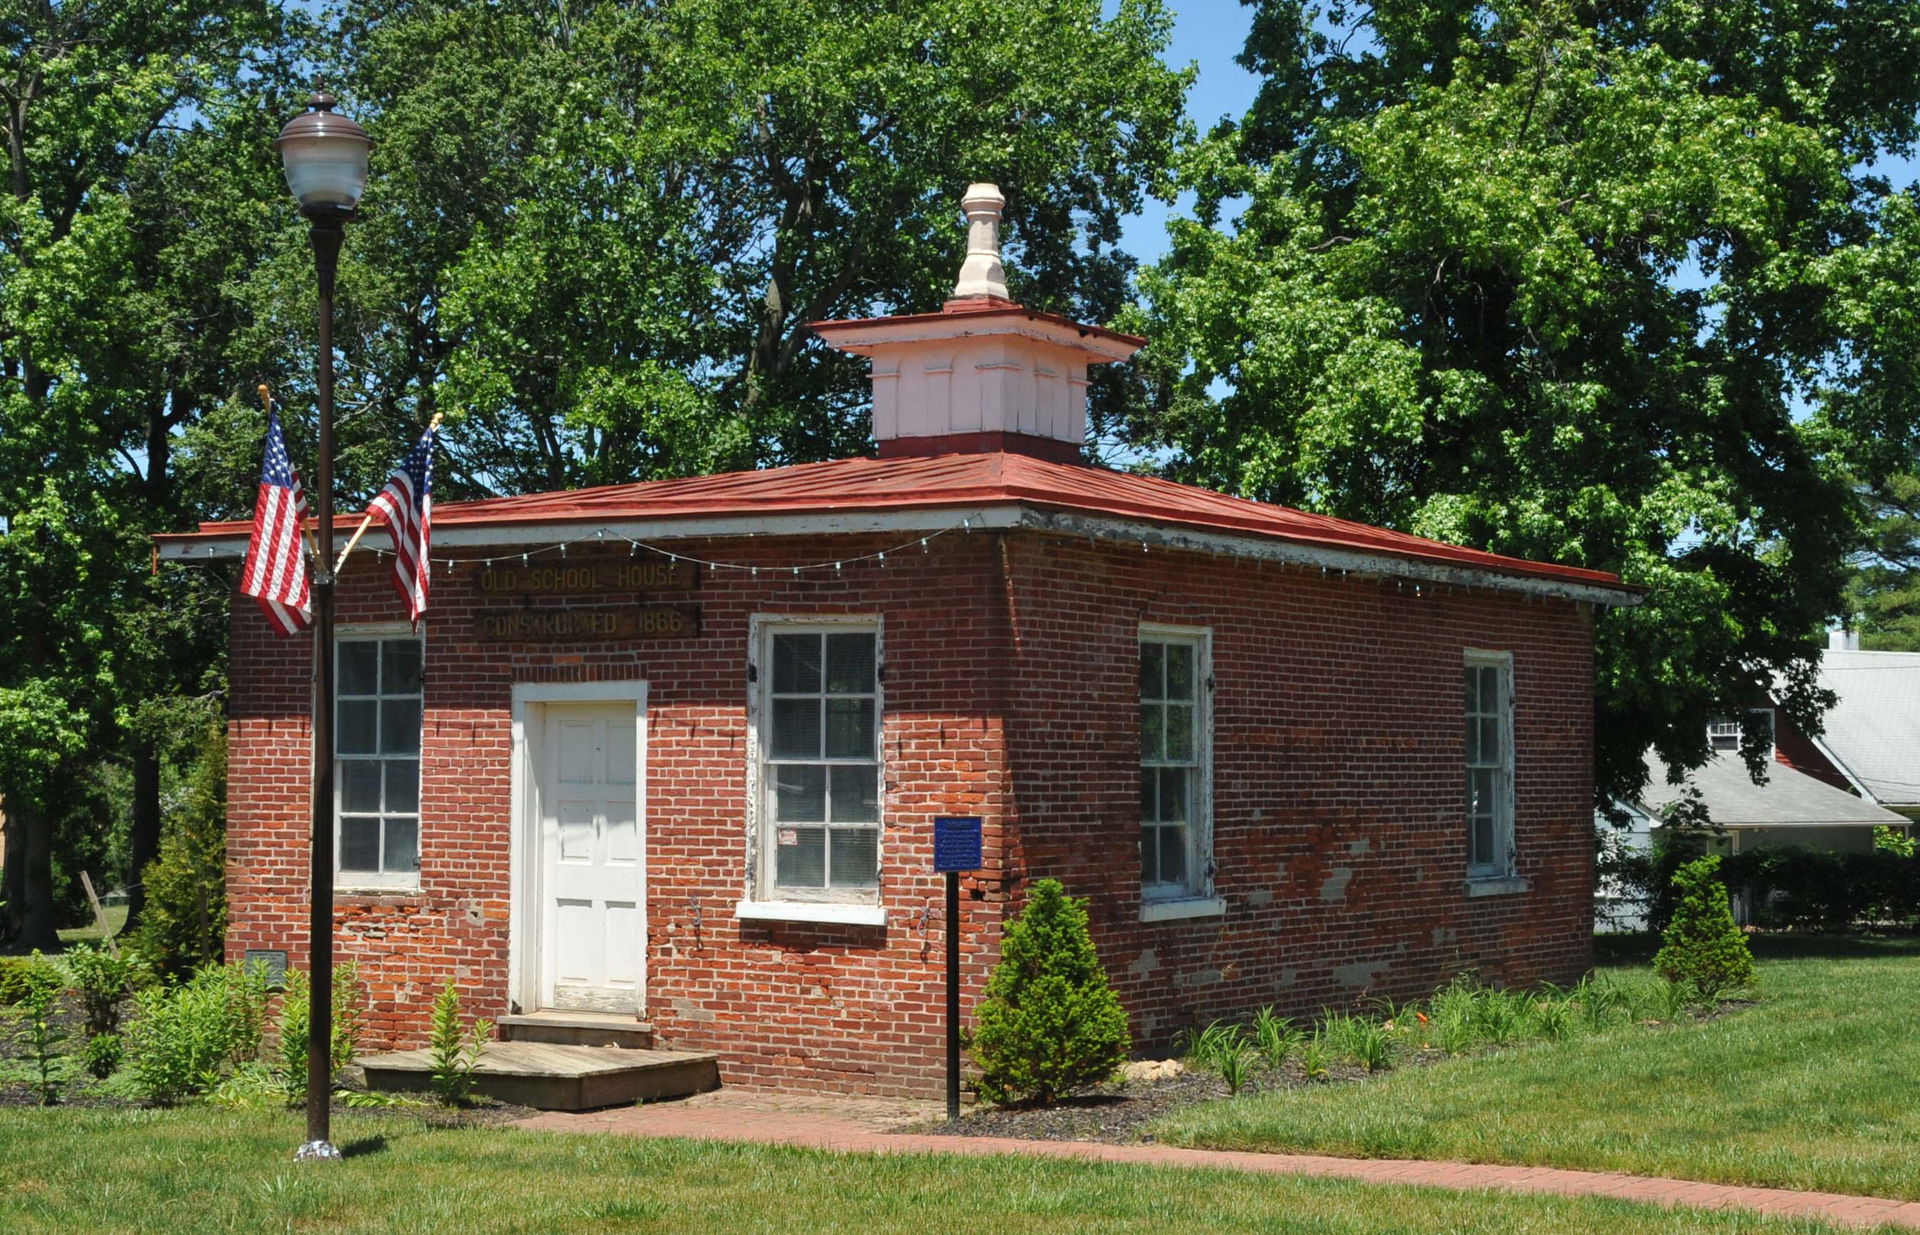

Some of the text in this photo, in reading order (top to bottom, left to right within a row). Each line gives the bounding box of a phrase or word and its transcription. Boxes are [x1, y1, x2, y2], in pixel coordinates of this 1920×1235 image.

[481, 564, 680, 591] OLD SCHOOL HOUSE
[640, 611, 682, 633] 1866
